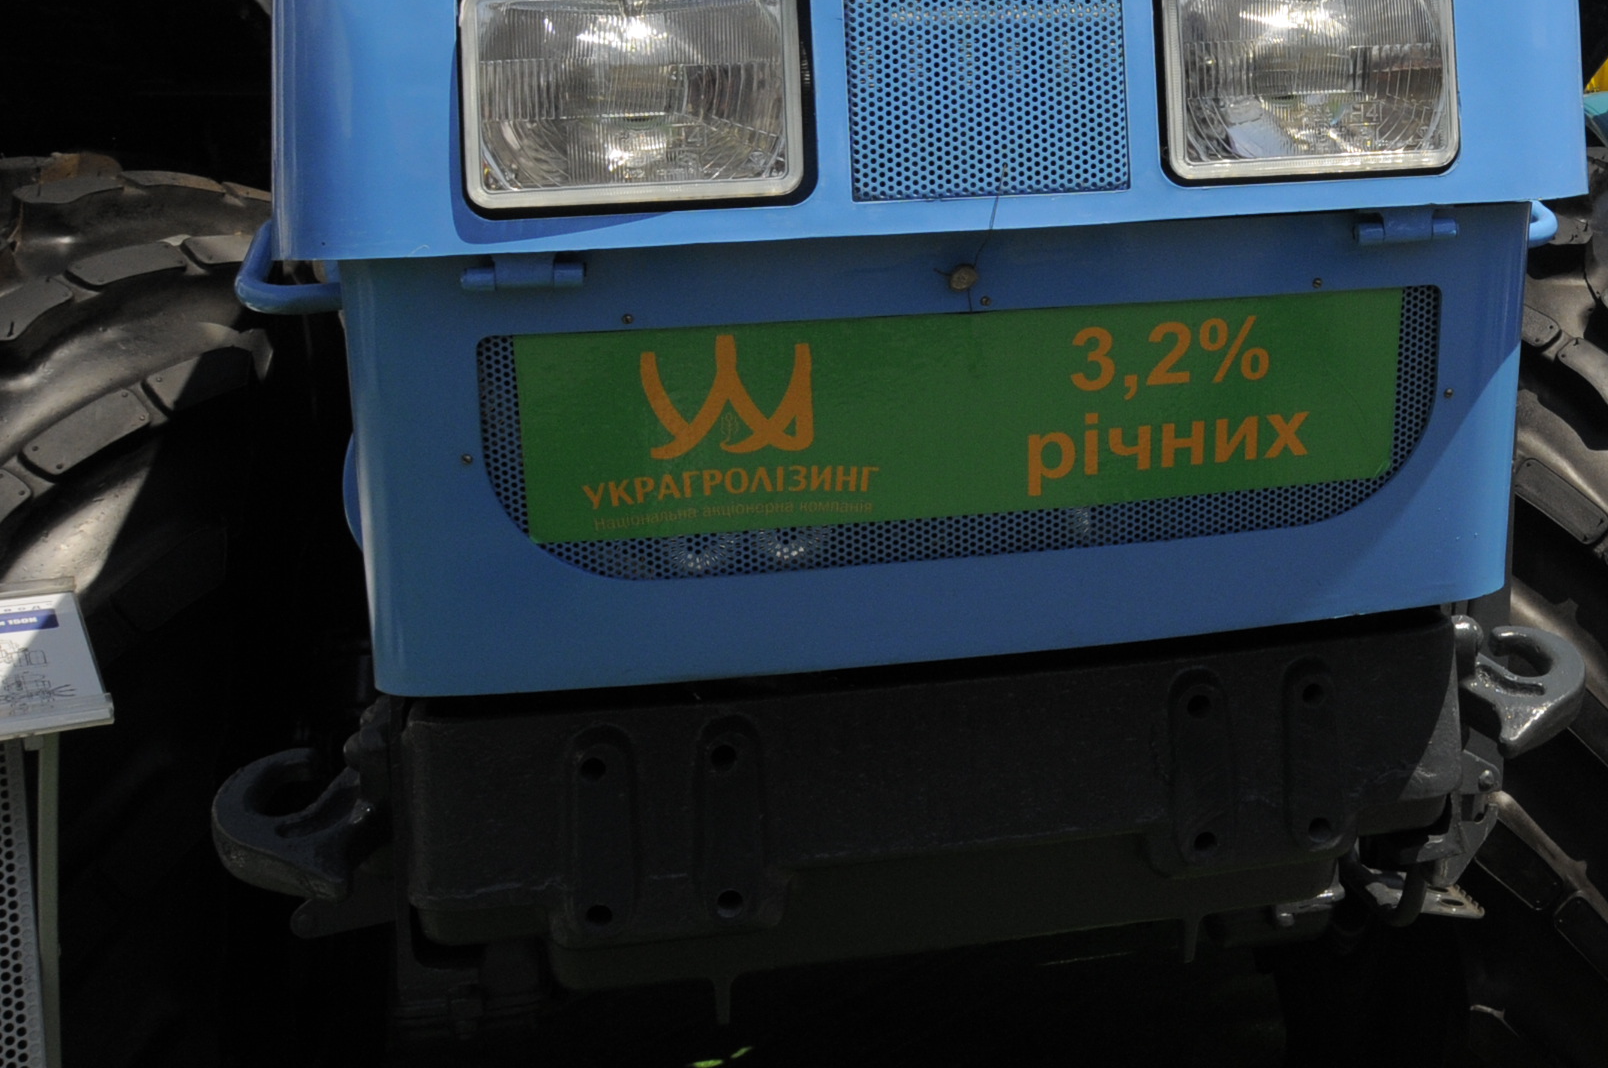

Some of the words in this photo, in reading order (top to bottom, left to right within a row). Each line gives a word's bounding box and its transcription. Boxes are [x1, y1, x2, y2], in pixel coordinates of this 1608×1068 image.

[1071, 316, 1270, 400] 3,2%
[1028, 412, 1310, 496] річних
[582, 465, 880, 509] УКРАГРОЛІЗИНГ
[593, 506, 697, 532] Національна
[799, 498, 873, 514] компанія
